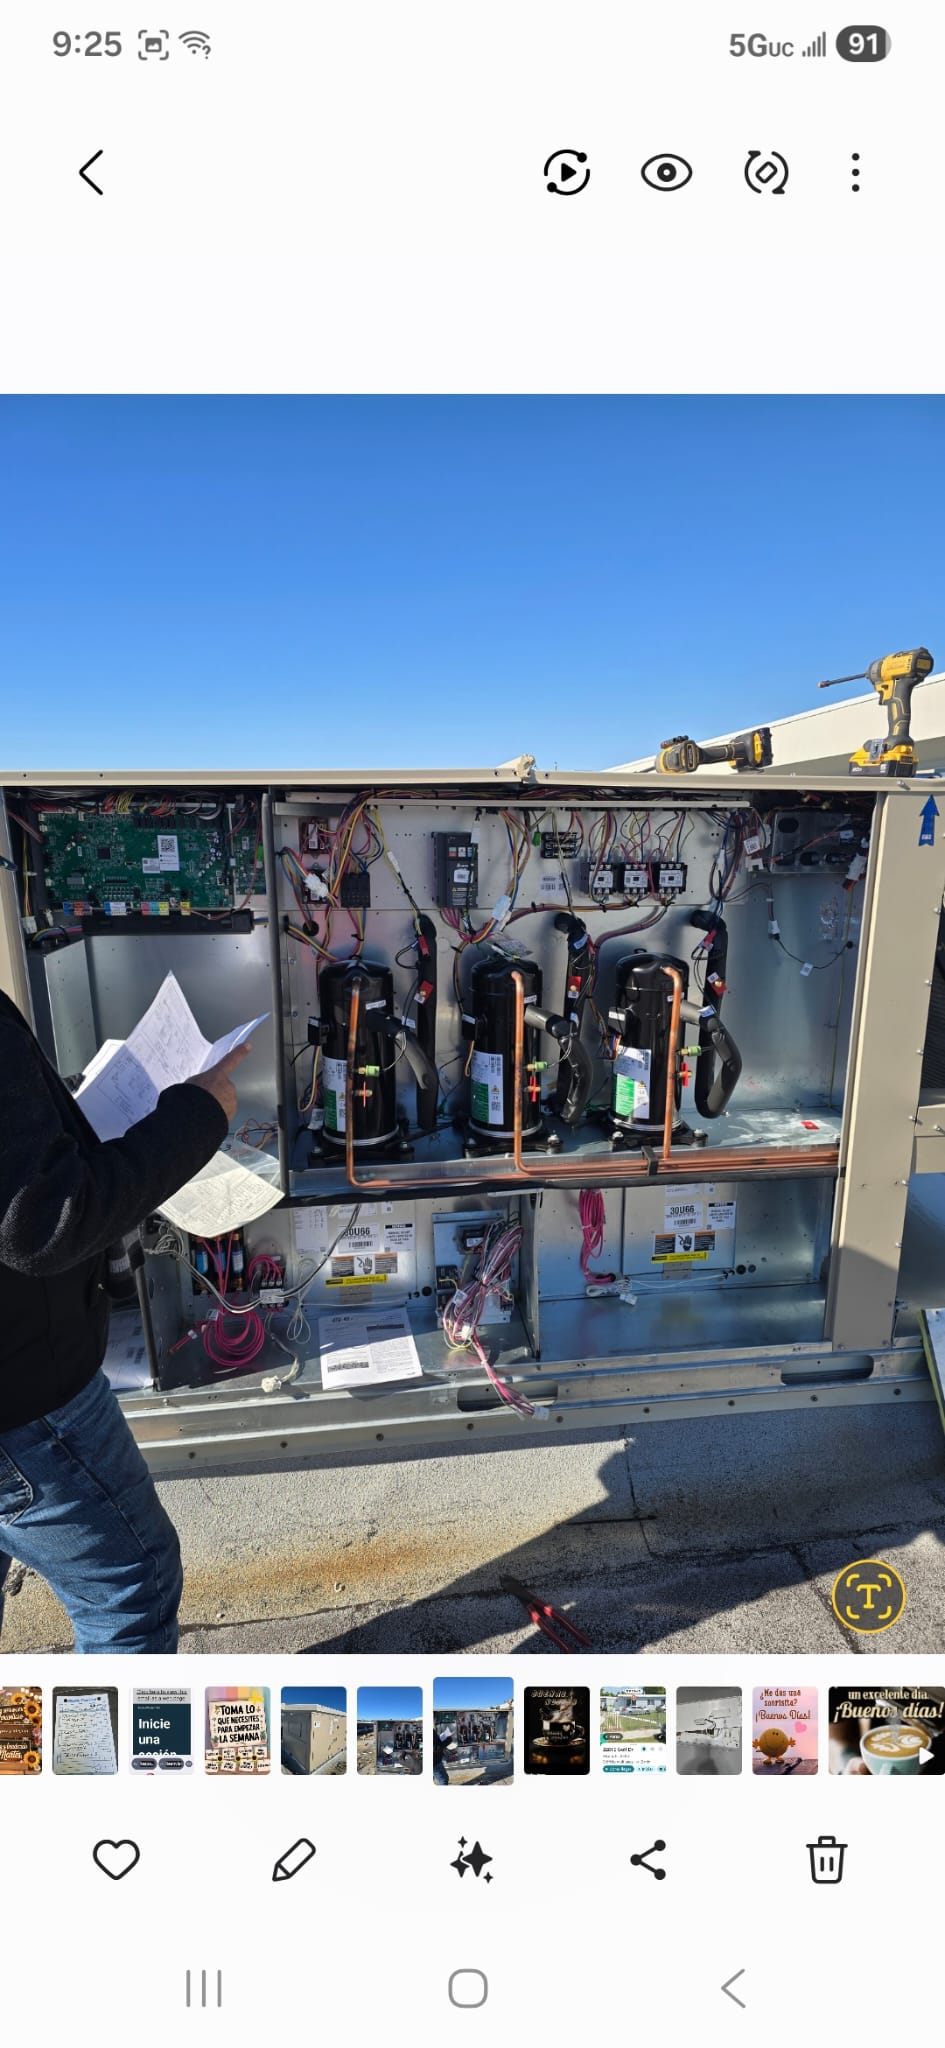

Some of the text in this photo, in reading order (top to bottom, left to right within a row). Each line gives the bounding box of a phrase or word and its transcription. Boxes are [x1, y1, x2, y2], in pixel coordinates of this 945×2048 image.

[53, 31, 122, 57] 9:25
[849, 32, 878, 55] 91
[670, 1205, 695, 1215] 30U66
[847, 1691, 861, 1700] un
[862, 1687, 909, 1700] excelente
[219, 1704, 256, 1715] TOMA LO
[902, 1701, 944, 1718] días!
[138, 1718, 171, 1729] Inicie
[217, 1715, 260, 1725] QUE NECESITES
[217, 1723, 260, 1734] PARA EMPEZAR
[138, 1736, 160, 1745] una
[219, 1732, 260, 1743] LA SEMANA
